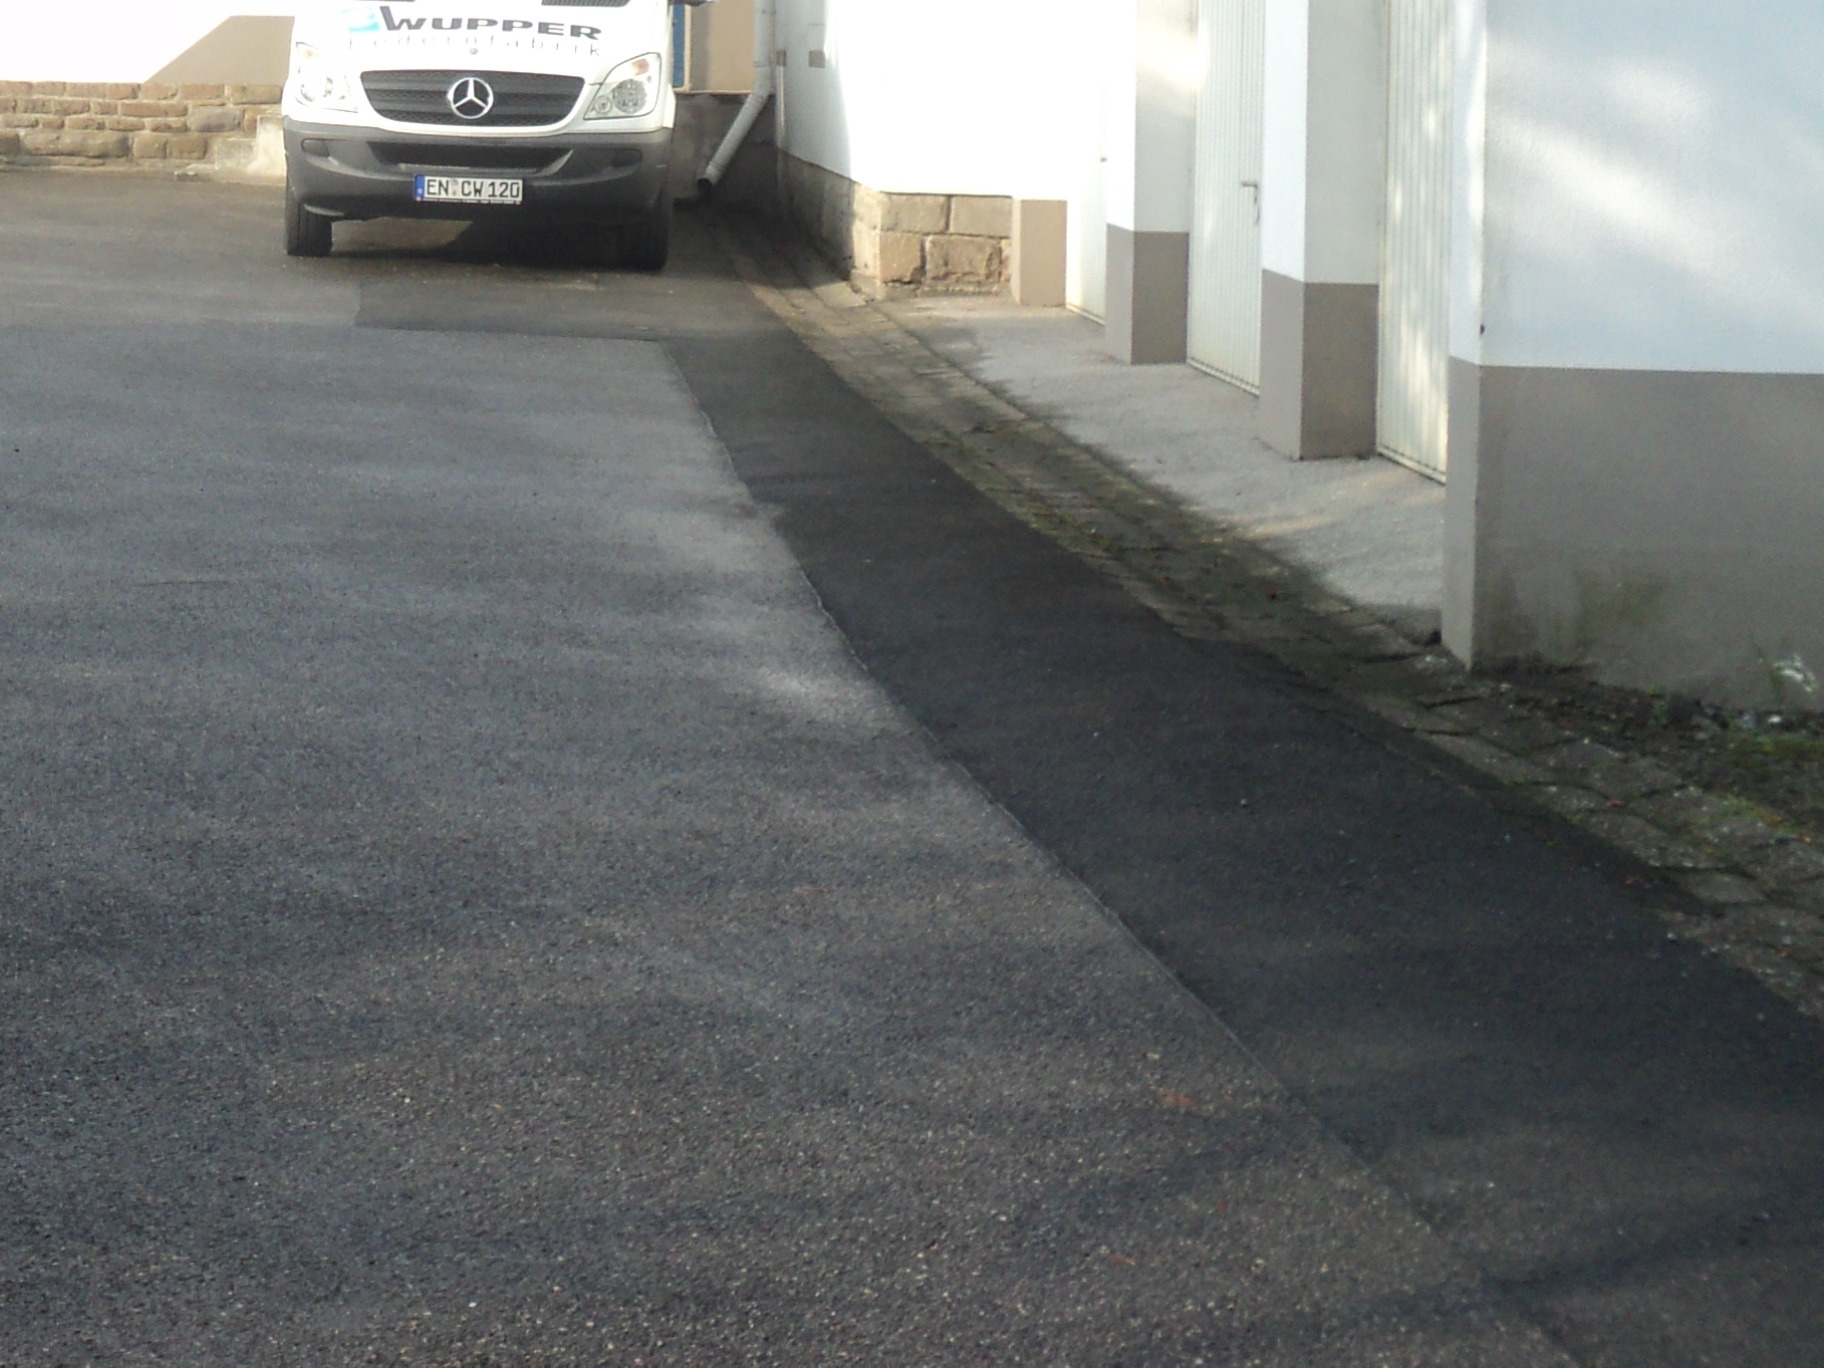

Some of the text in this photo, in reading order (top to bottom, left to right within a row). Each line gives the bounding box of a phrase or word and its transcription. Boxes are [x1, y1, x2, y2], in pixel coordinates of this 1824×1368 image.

[379, 5, 603, 41] WUPPER
[426, 179, 520, 198] EN CW 120
